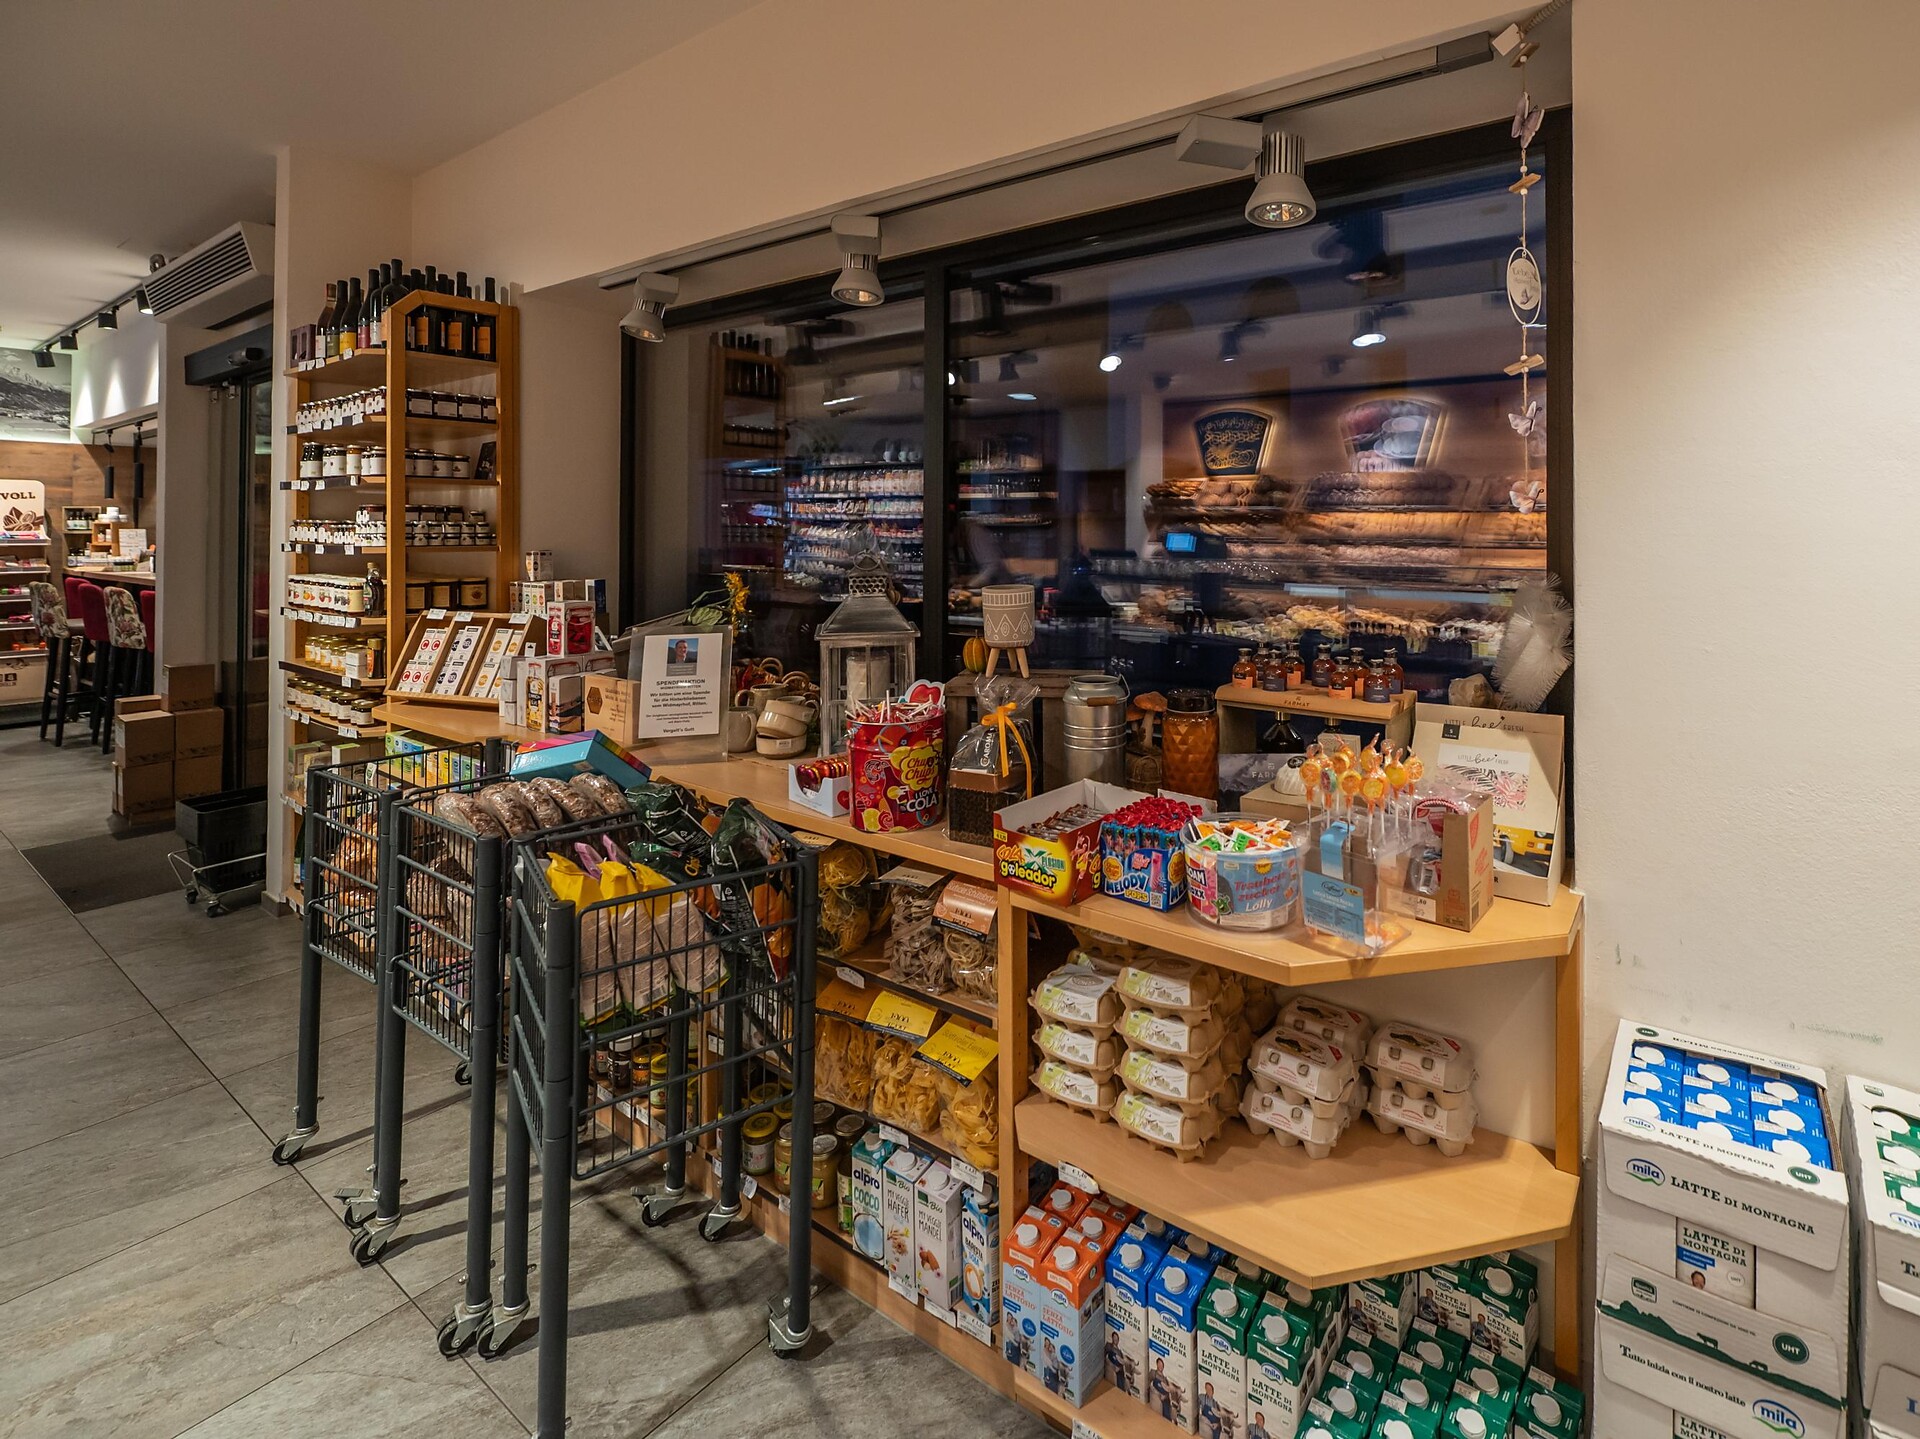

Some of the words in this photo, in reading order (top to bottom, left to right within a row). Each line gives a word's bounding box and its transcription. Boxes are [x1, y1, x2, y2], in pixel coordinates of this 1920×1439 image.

[905, 767, 936, 785] Chups
[906, 794, 938, 813] COLA
[1105, 873, 1148, 894] MELODY
[1245, 898, 1273, 912] Lolly
[1627, 1117, 1653, 1130] mila
[1659, 1127, 1702, 1147] LATTE
[1716, 1145, 1776, 1170] MONTAGNA
[1794, 1170, 1813, 1184] UHT
[853, 1168, 880, 1190] alpro
[897, 1180, 911, 1192] Bio
[854, 1186, 880, 1212] COCCO
[928, 1201, 943, 1214] Bio
[1629, 1161, 1661, 1182] mila
[1671, 1175, 1721, 1203] LATTE
[1724, 1194, 1739, 1209] DI
[1741, 1203, 1816, 1235] MONTAGNA
[887, 1199, 910, 1224] HAFER
[918, 1220, 943, 1242] MANDEL
[962, 1217, 985, 1247] alpro
[1897, 1215, 1920, 1230] mil
[1682, 1238, 1747, 1267] MONTAGNA
[1683, 1226, 1730, 1252] LATTE
[1732, 1246, 1746, 1258] DI
[1015, 1267, 1029, 1280] mila
[1053, 1292, 1068, 1304] mila
[1118, 1289, 1132, 1302] mila
[1434, 1290, 1460, 1305] LATTE
[1107, 1307, 1142, 1333] MONTAGNA
[1108, 1299, 1134, 1320] LATTE
[1363, 1301, 1387, 1318] LATTE
[1161, 1314, 1178, 1328] mila
[1486, 1315, 1512, 1333] LATTE
[1151, 1324, 1179, 1345] LATTE
[1151, 1332, 1188, 1358] MONTAGNA
[1213, 1337, 1230, 1351] mila
[1780, 1341, 1802, 1357] UHT
[1201, 1349, 1231, 1371] LATTE
[1231, 1365, 1240, 1376] DI
[1201, 1358, 1241, 1384] MONTAGNA
[1264, 1365, 1282, 1381] mila
[1619, 1343, 1646, 1368] Tutto
[1646, 1356, 1671, 1376] inizia
[1671, 1367, 1688, 1382] con
[1695, 1377, 1724, 1399] nostro
[1724, 1388, 1746, 1408] latte
[1251, 1377, 1283, 1400] LATTE
[1283, 1395, 1293, 1407] DI
[1251, 1386, 1294, 1415] MONTAGNA
[1680, 1415, 1727, 1439] LATTE
[1760, 1406, 1798, 1431] mila
